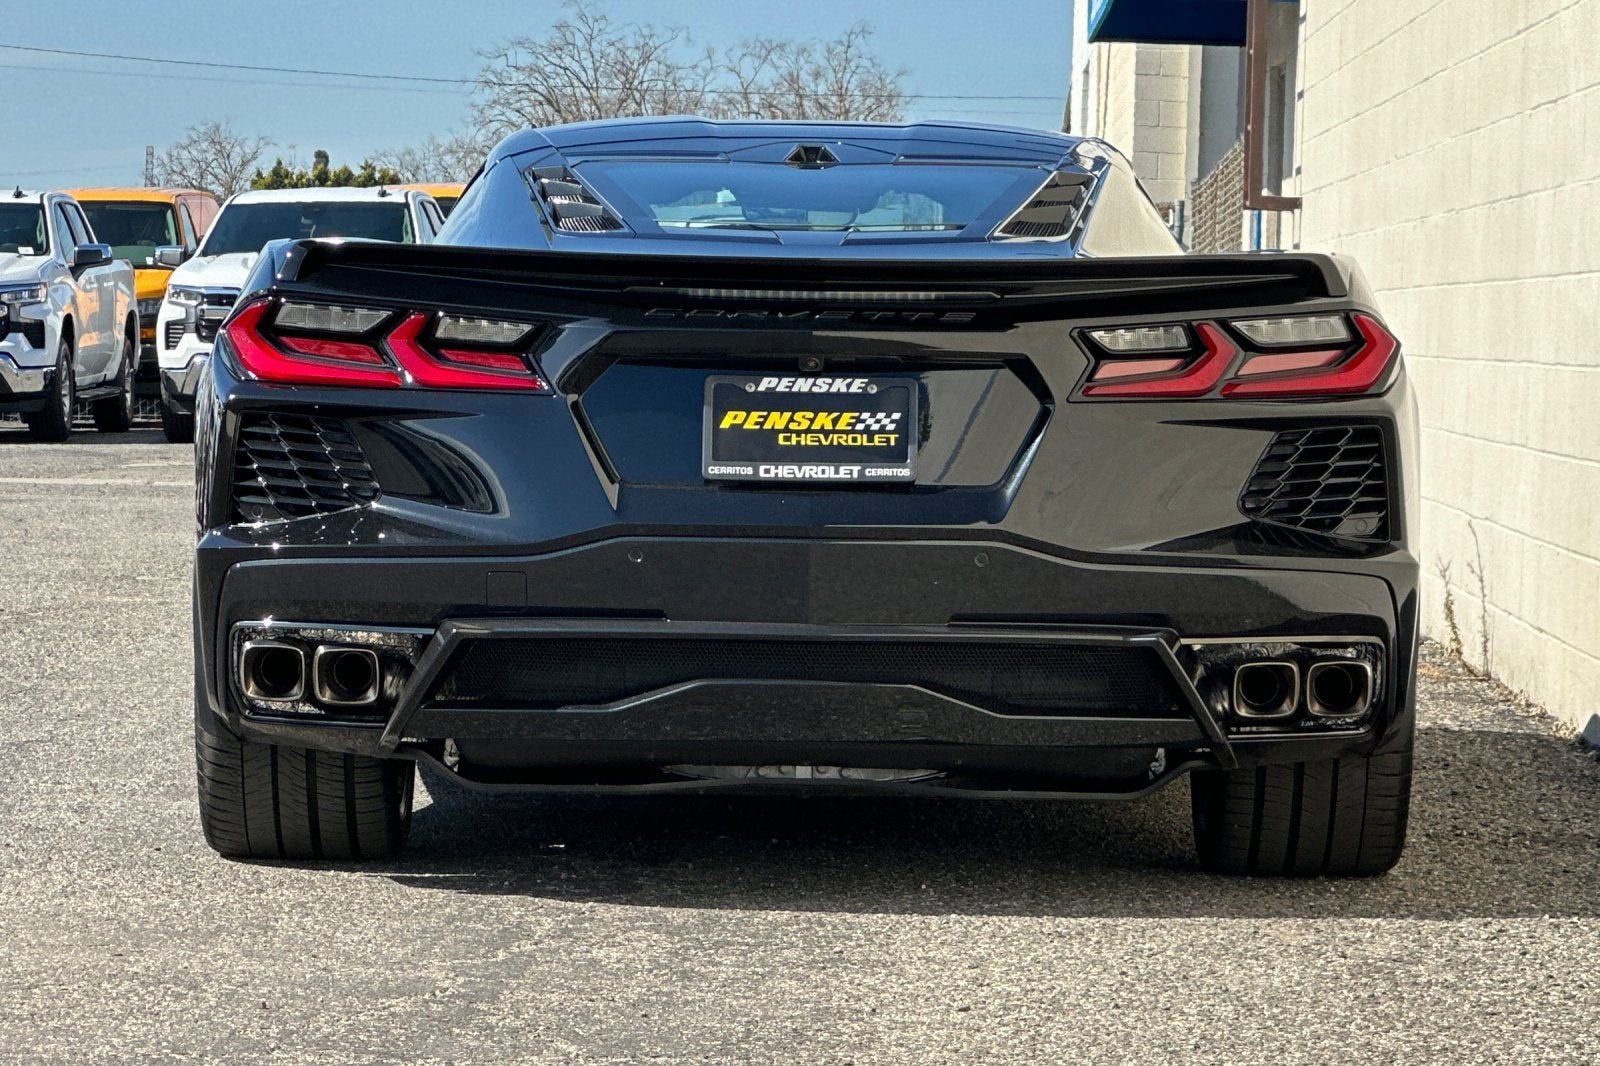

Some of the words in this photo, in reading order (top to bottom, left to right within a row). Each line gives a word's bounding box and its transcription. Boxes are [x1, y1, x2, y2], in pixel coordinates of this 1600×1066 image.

[757, 377, 868, 393] PENSKE
[719, 410, 860, 430] PENSKE
[778, 433, 899, 446] CHEVROLET
[708, 466, 753, 475] CERRITOS
[759, 465, 862, 479] CHEVROLET
[865, 468, 910, 477] CERRITOS
